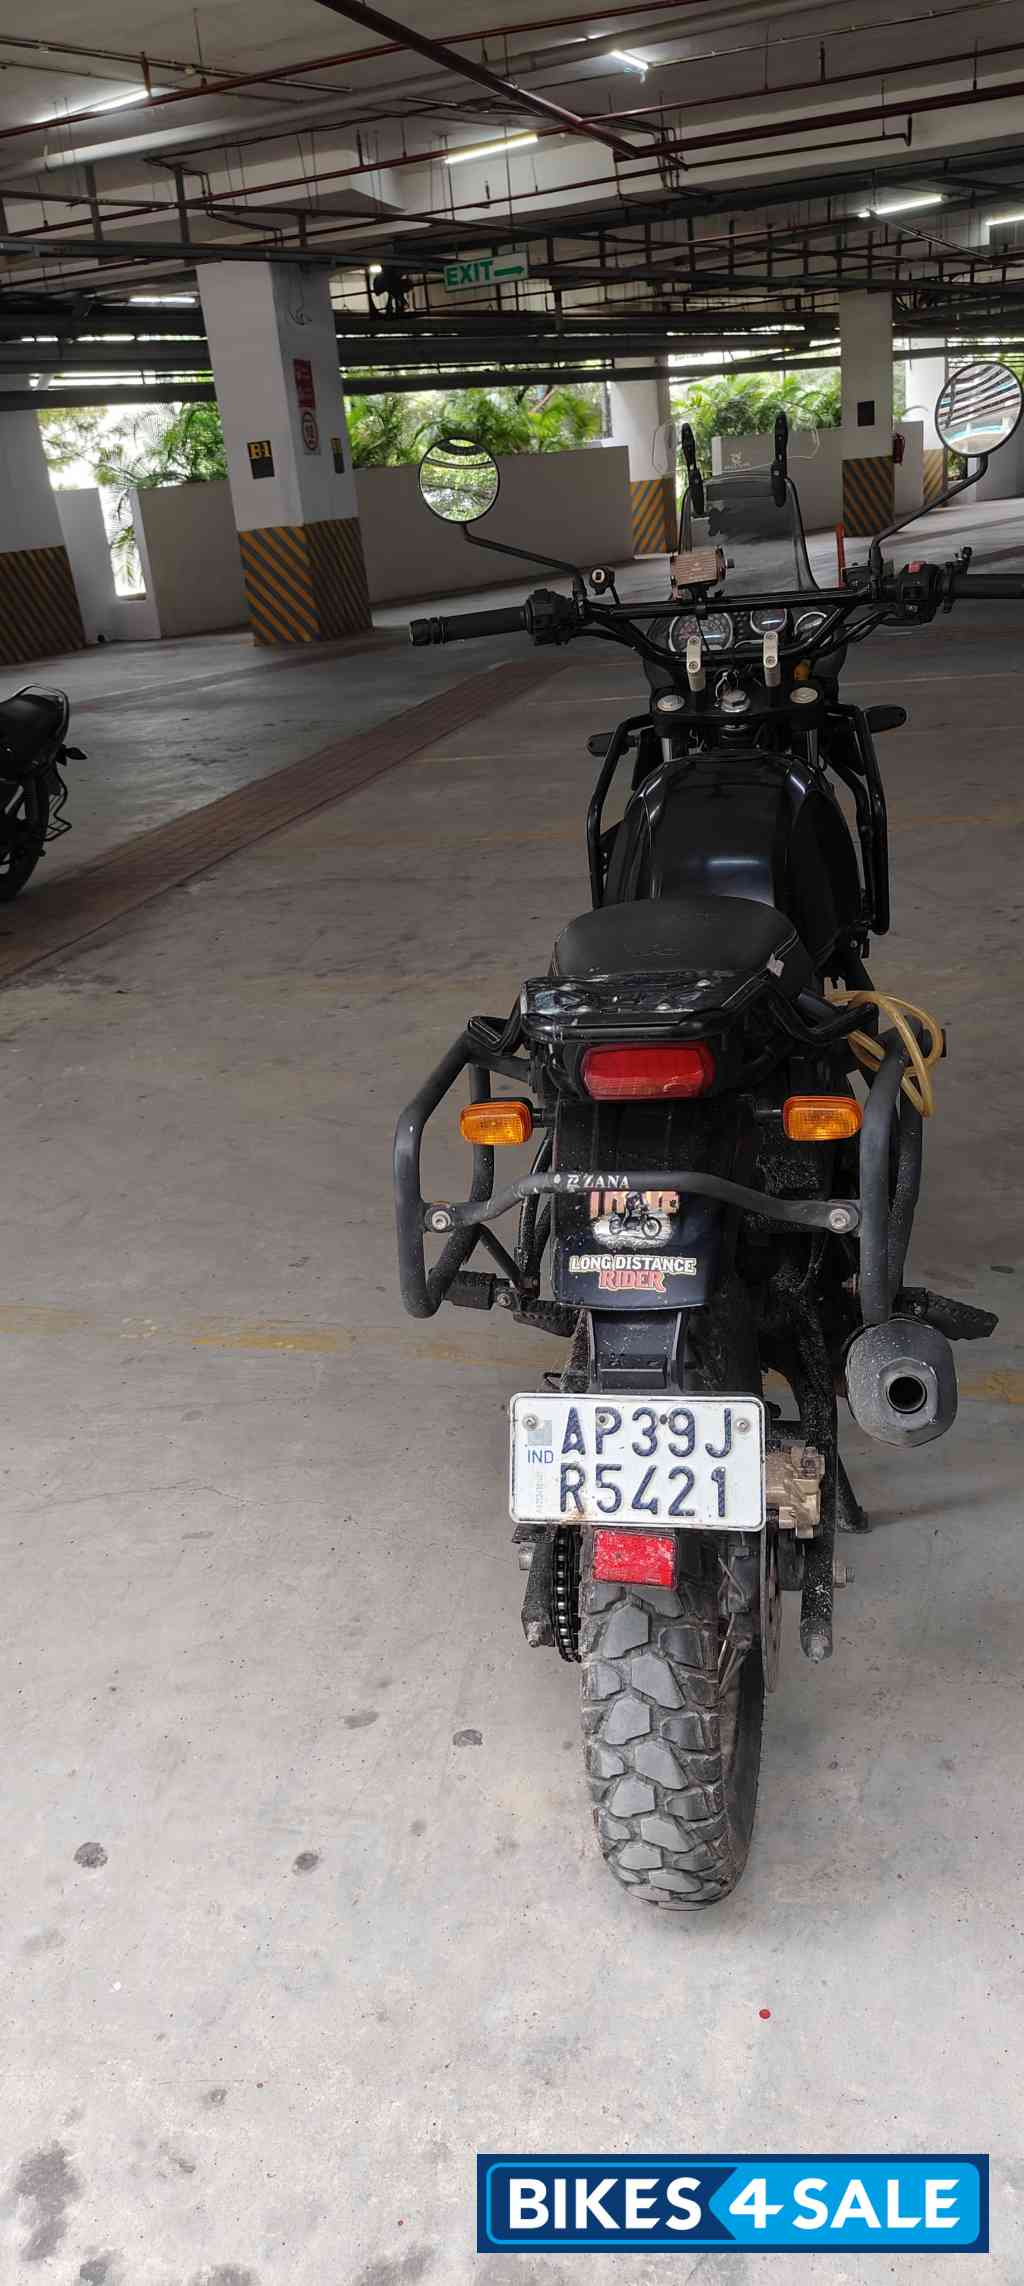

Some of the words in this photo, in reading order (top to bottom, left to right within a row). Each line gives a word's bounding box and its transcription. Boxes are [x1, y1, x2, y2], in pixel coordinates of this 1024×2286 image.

[446, 259, 493, 286] EXIT
[584, 1174, 630, 1189] ZANA
[570, 1254, 613, 1272] LONG
[614, 1254, 697, 1273] DISTANCE
[599, 1270, 665, 1291] RIDER
[561, 1406, 732, 1459] AP39J
[527, 1449, 554, 1464] IND
[560, 1463, 726, 1517] R5421
